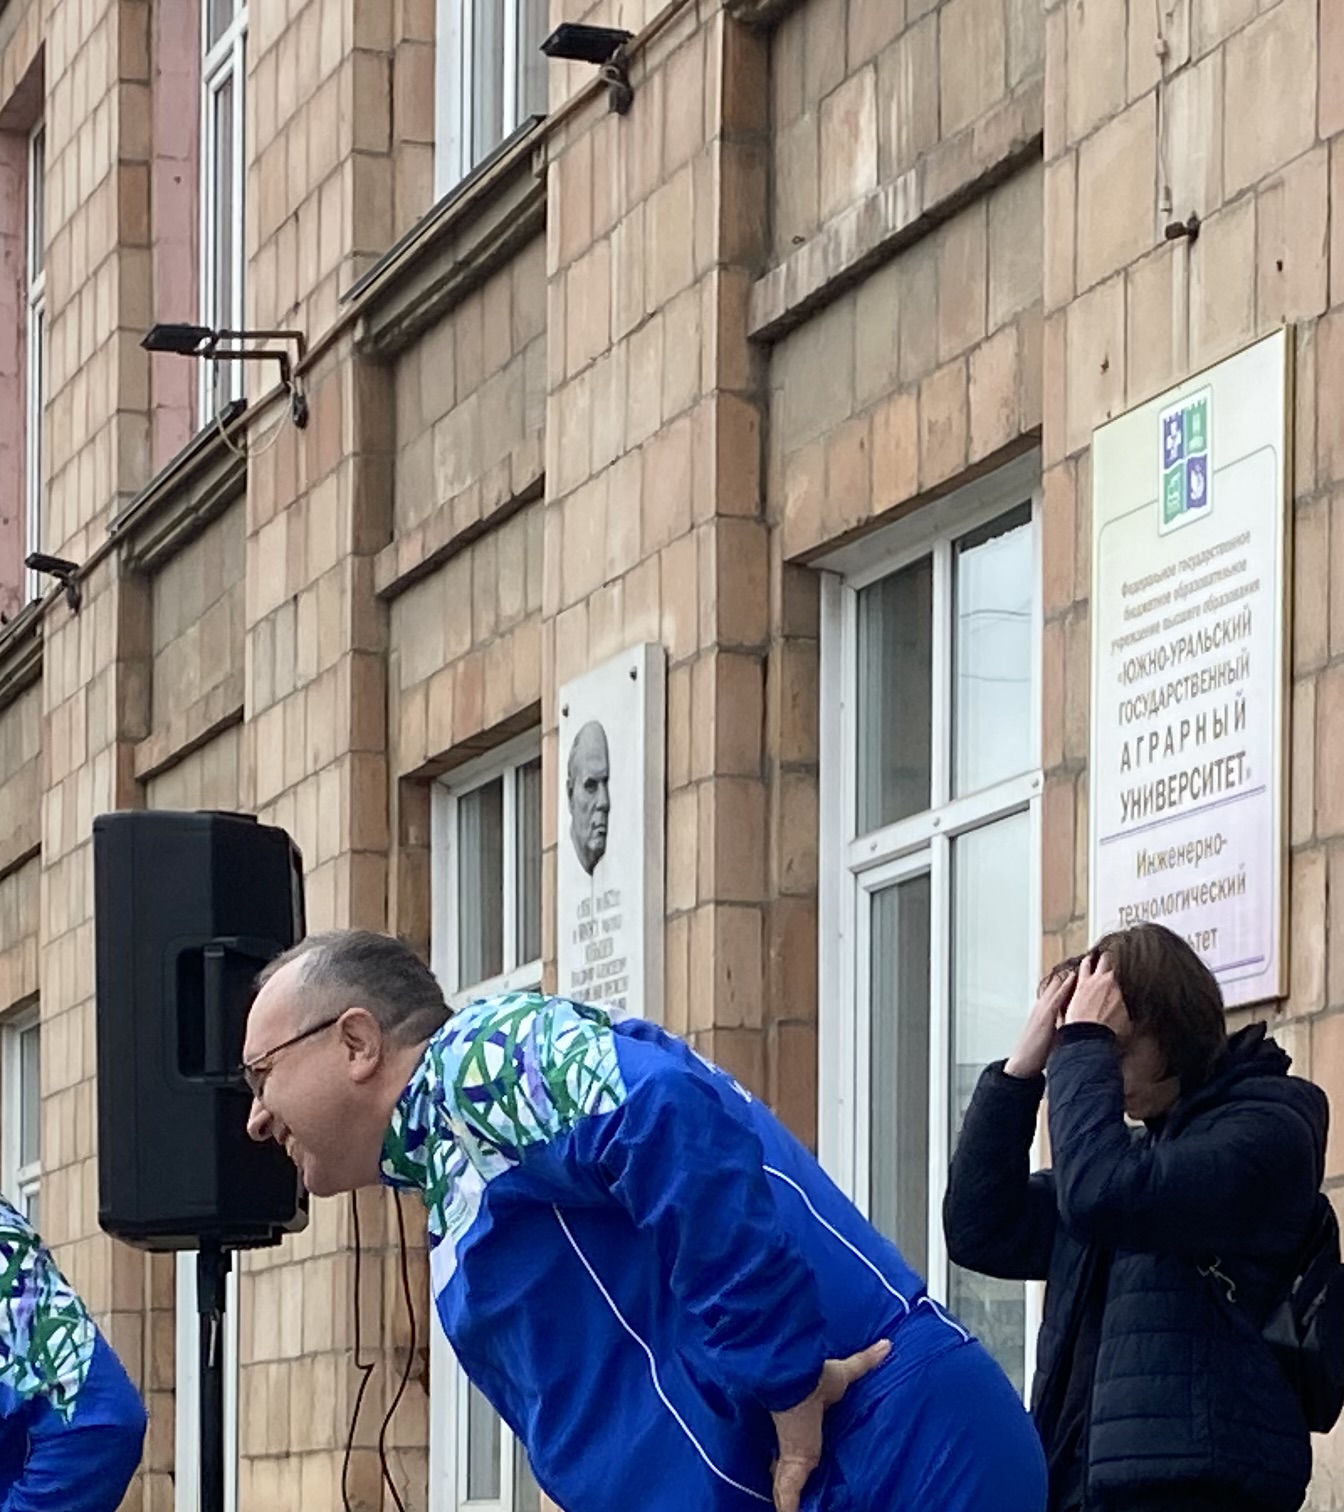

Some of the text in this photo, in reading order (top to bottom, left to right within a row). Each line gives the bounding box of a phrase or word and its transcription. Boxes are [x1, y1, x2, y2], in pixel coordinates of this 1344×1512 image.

[1119, 648, 1250, 726] ГОСУДАРСТВЕННЫЙ
[1120, 689, 1246, 774] АГРАРНЫЙ
[1136, 833, 1228, 879] Инженерно-
[1118, 862, 1247, 927] технологический
